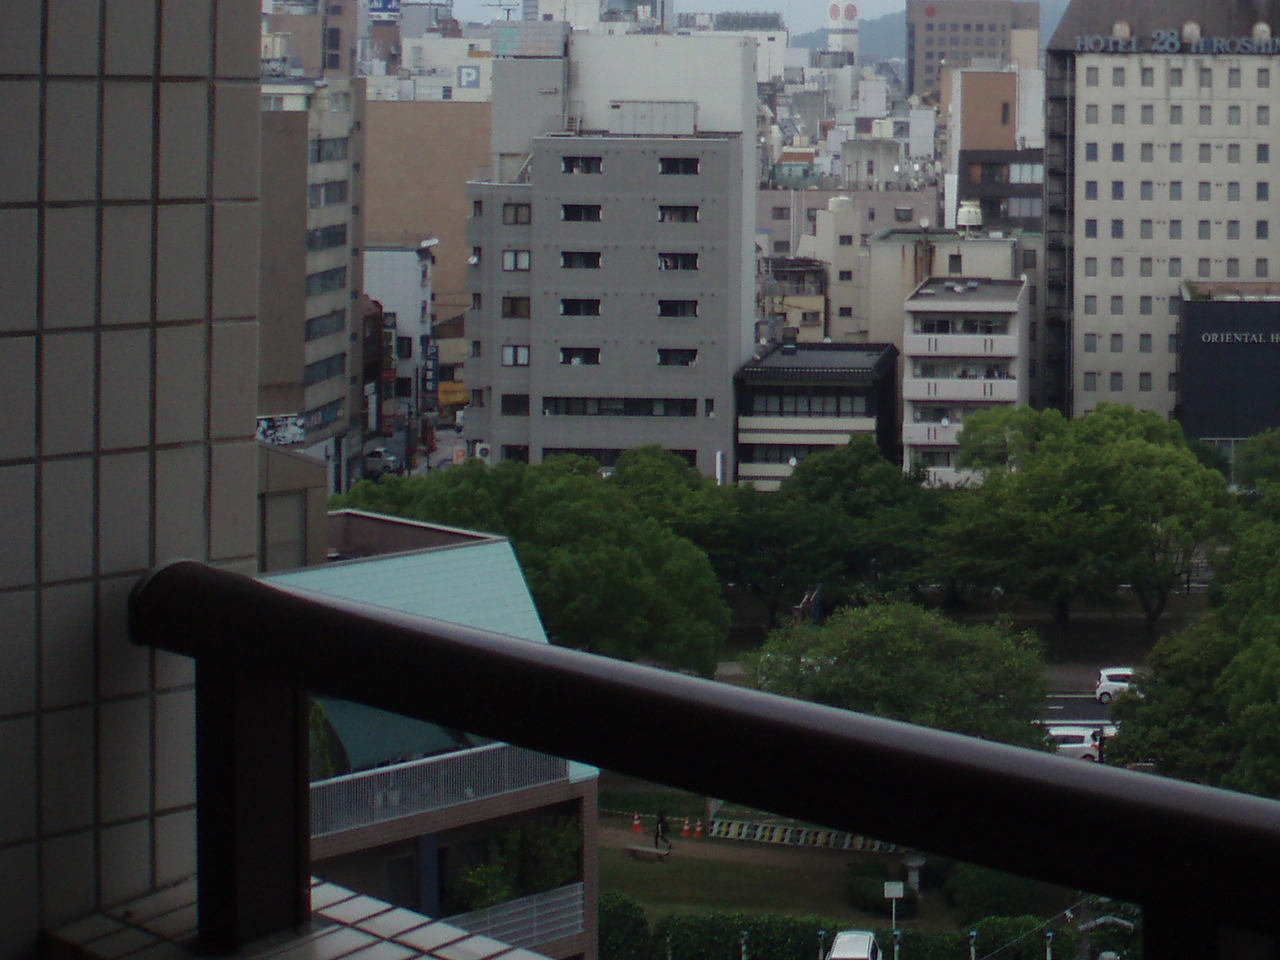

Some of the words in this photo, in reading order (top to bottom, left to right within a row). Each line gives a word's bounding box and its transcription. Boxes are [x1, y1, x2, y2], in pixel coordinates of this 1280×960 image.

[1075, 34, 1142, 52] HOTEL
[1151, 29, 1181, 52] 28
[461, 67, 477, 86] P
[1201, 332, 1265, 343] ORIENTAL
